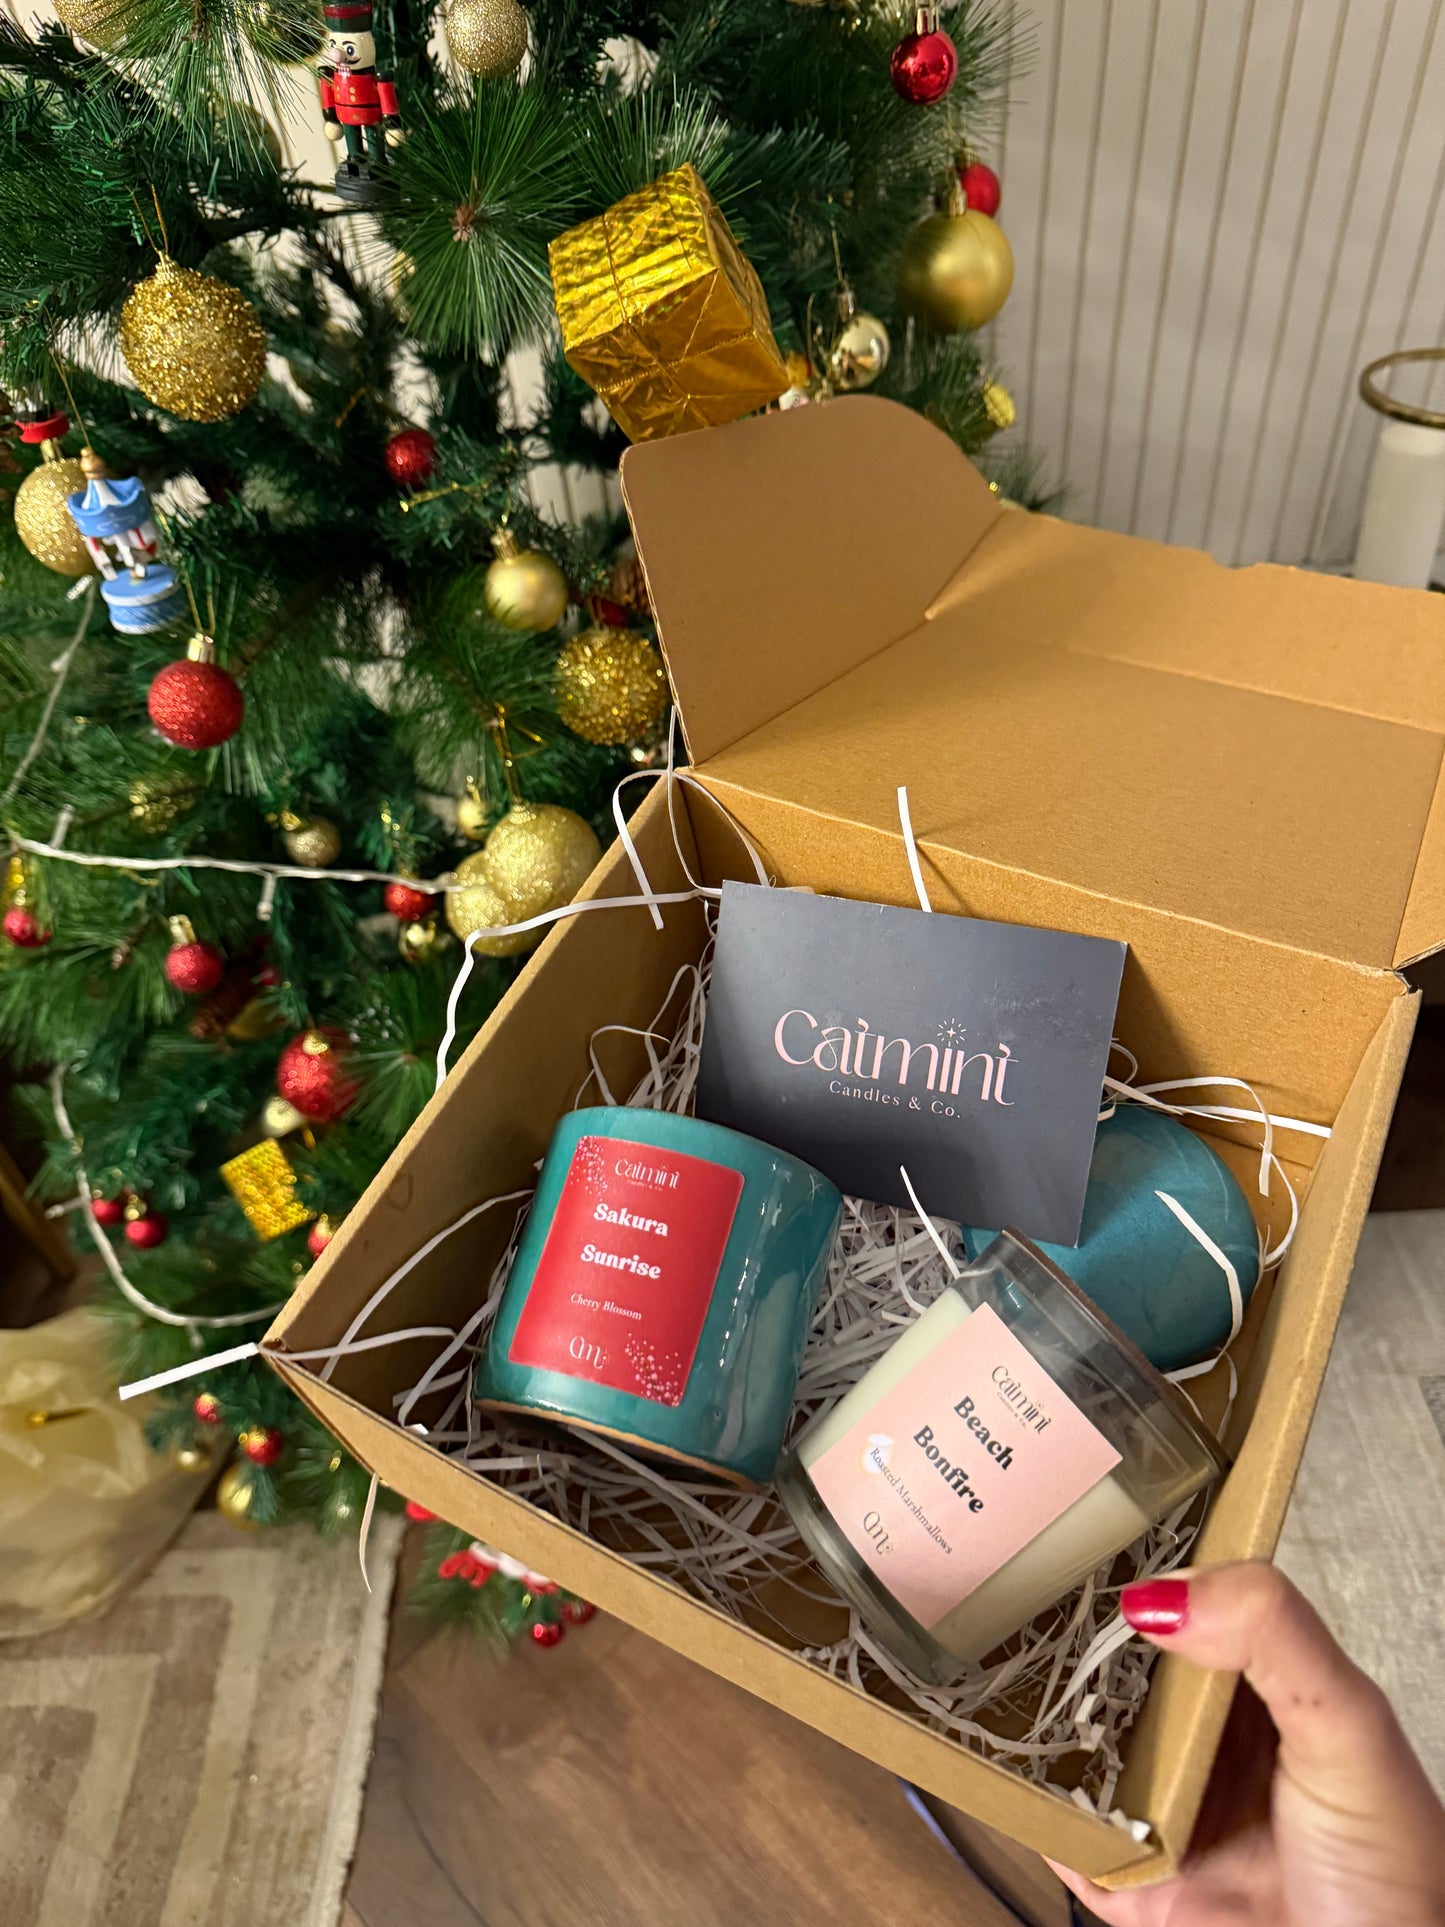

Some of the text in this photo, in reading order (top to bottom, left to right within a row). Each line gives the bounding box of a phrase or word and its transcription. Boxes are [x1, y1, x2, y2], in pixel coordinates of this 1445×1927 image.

[774, 1009, 1019, 1106] Catmint
[829, 1079, 961, 1119] Candles & Co.
[594, 1203, 669, 1237] Sakura
[580, 1244, 662, 1280] Sunrise
[570, 1293, 642, 1321] Cherry Blossom
[953, 1395, 1014, 1471] Beach
[913, 1425, 985, 1514] Bonfire
[870, 1447, 953, 1555] Roasted Marshmallows
